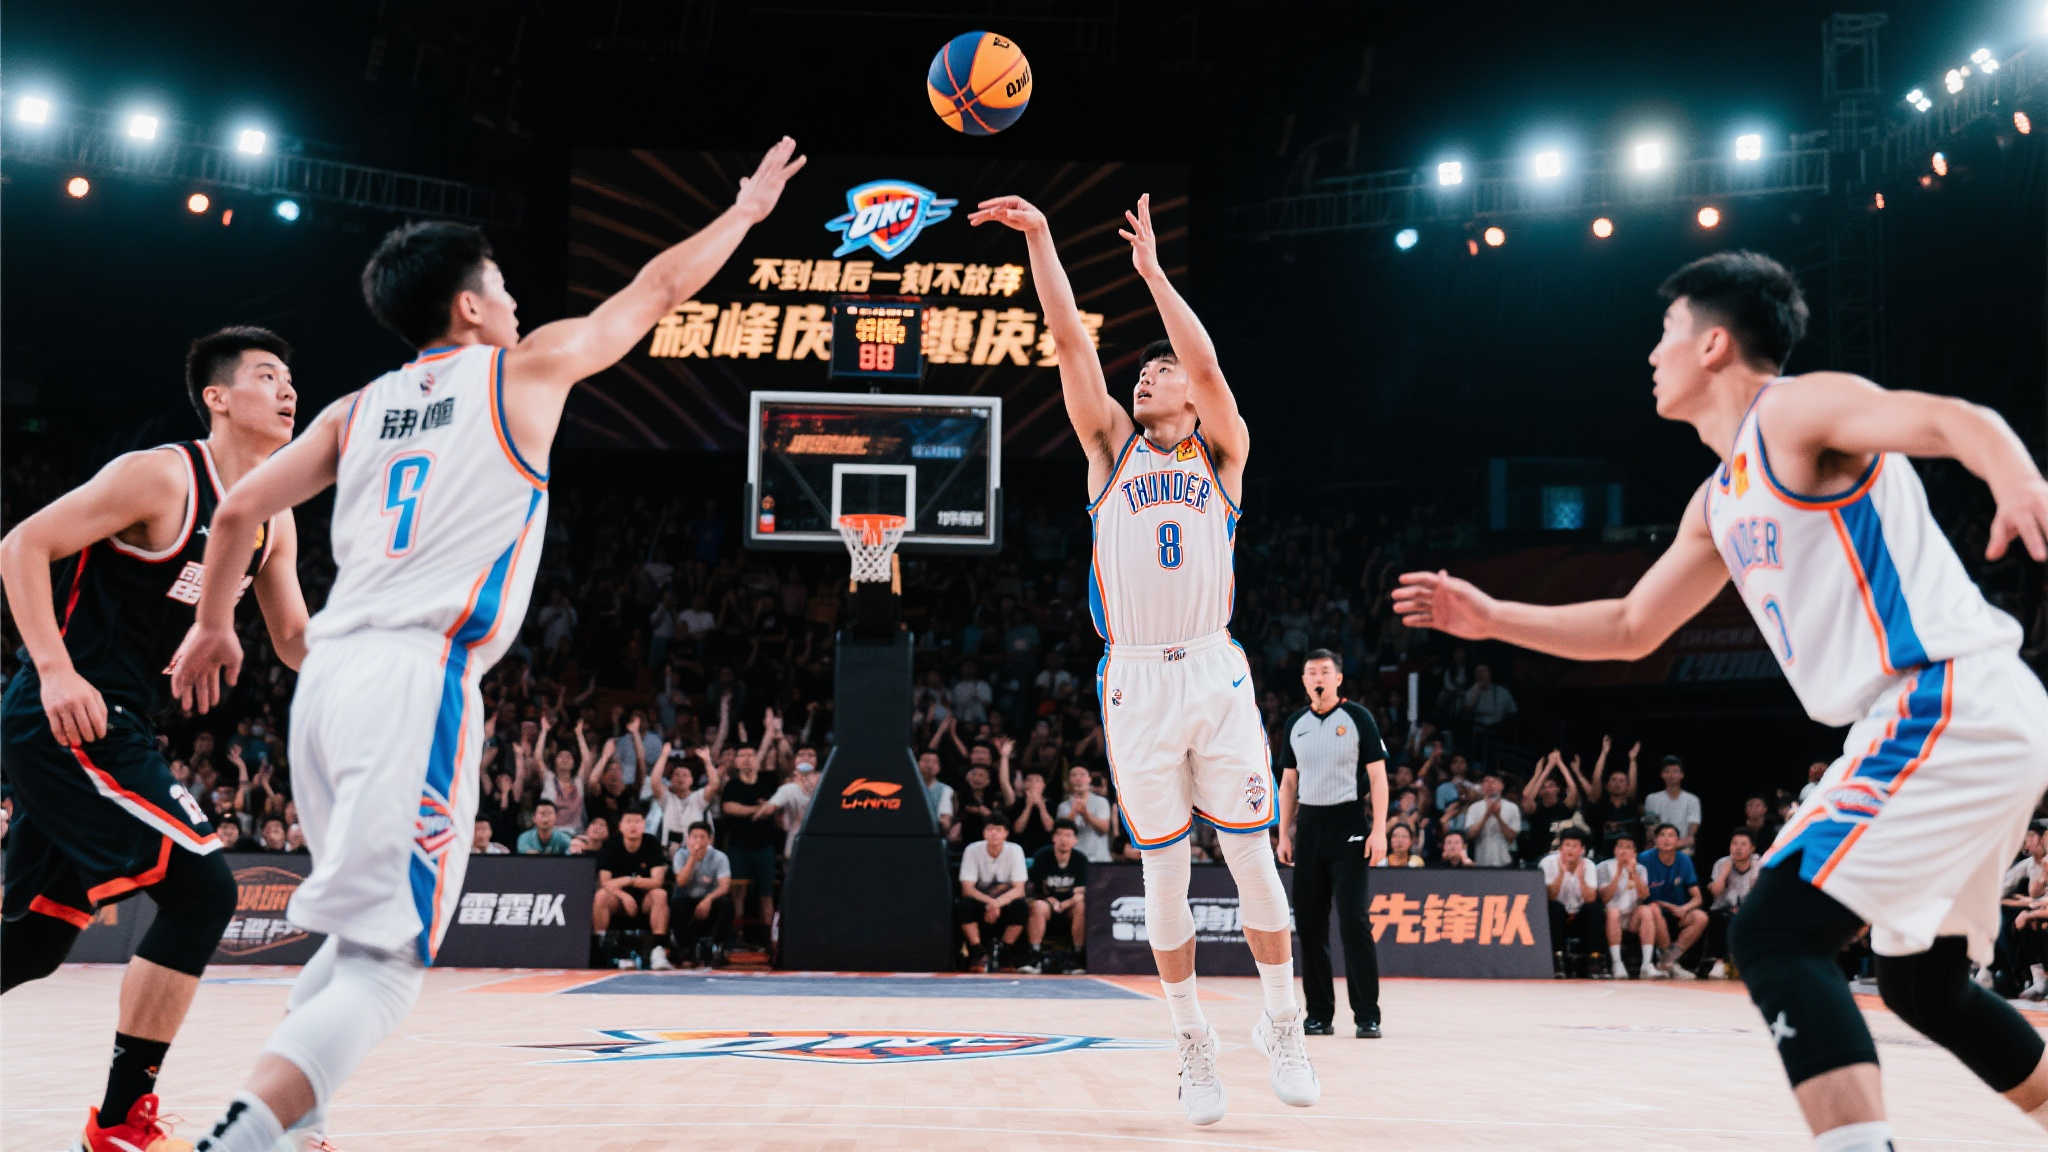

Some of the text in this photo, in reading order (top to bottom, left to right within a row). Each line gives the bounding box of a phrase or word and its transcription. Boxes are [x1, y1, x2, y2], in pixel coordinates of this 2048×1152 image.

[750, 258, 1024, 297] 不到最后一刻不放弃
[1121, 470, 1212, 515] THUNDER
[1157, 520, 1183, 570] 8
[458, 893, 566, 925] 雷霆队
[1368, 893, 1536, 946] 先锋队
